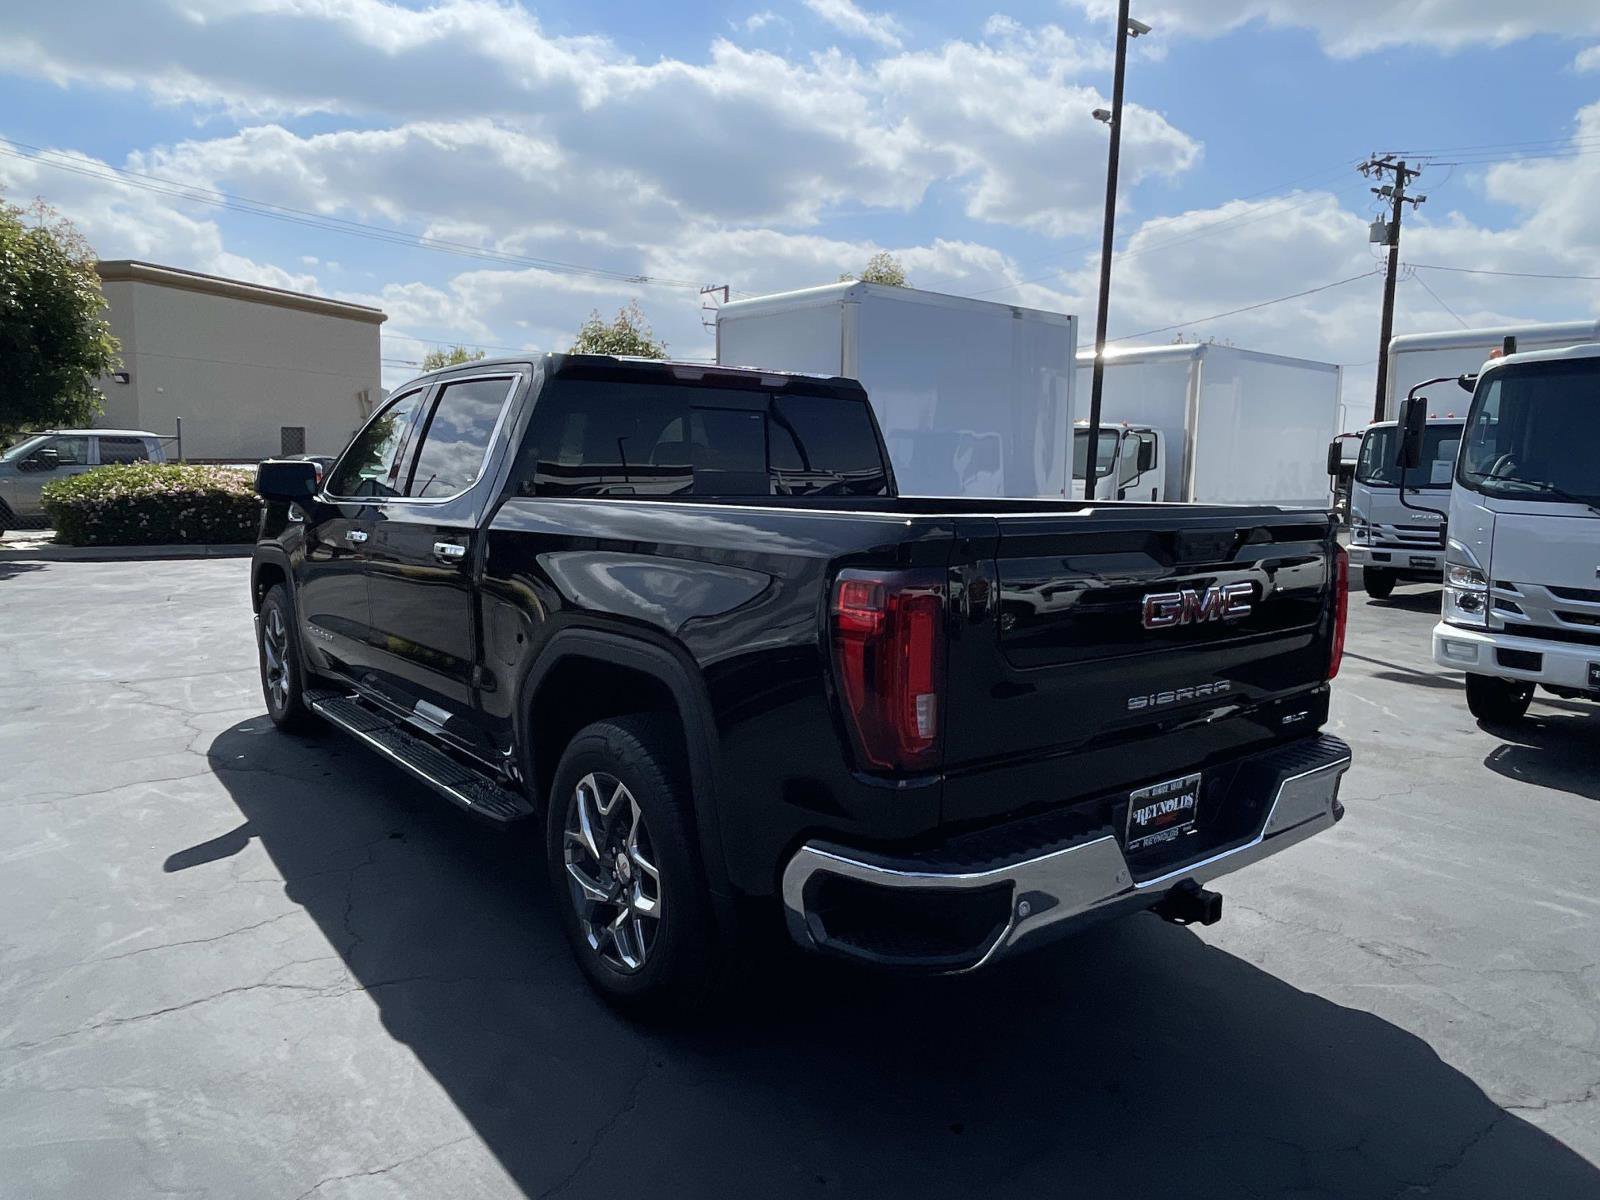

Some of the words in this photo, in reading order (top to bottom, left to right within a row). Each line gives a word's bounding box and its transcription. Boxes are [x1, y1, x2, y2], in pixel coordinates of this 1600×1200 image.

[1142, 582, 1254, 630] GMC
[1127, 679, 1231, 710] SIERRA
[1282, 711, 1309, 724] SLT
[1132, 792, 1195, 826] REYNOLDS
